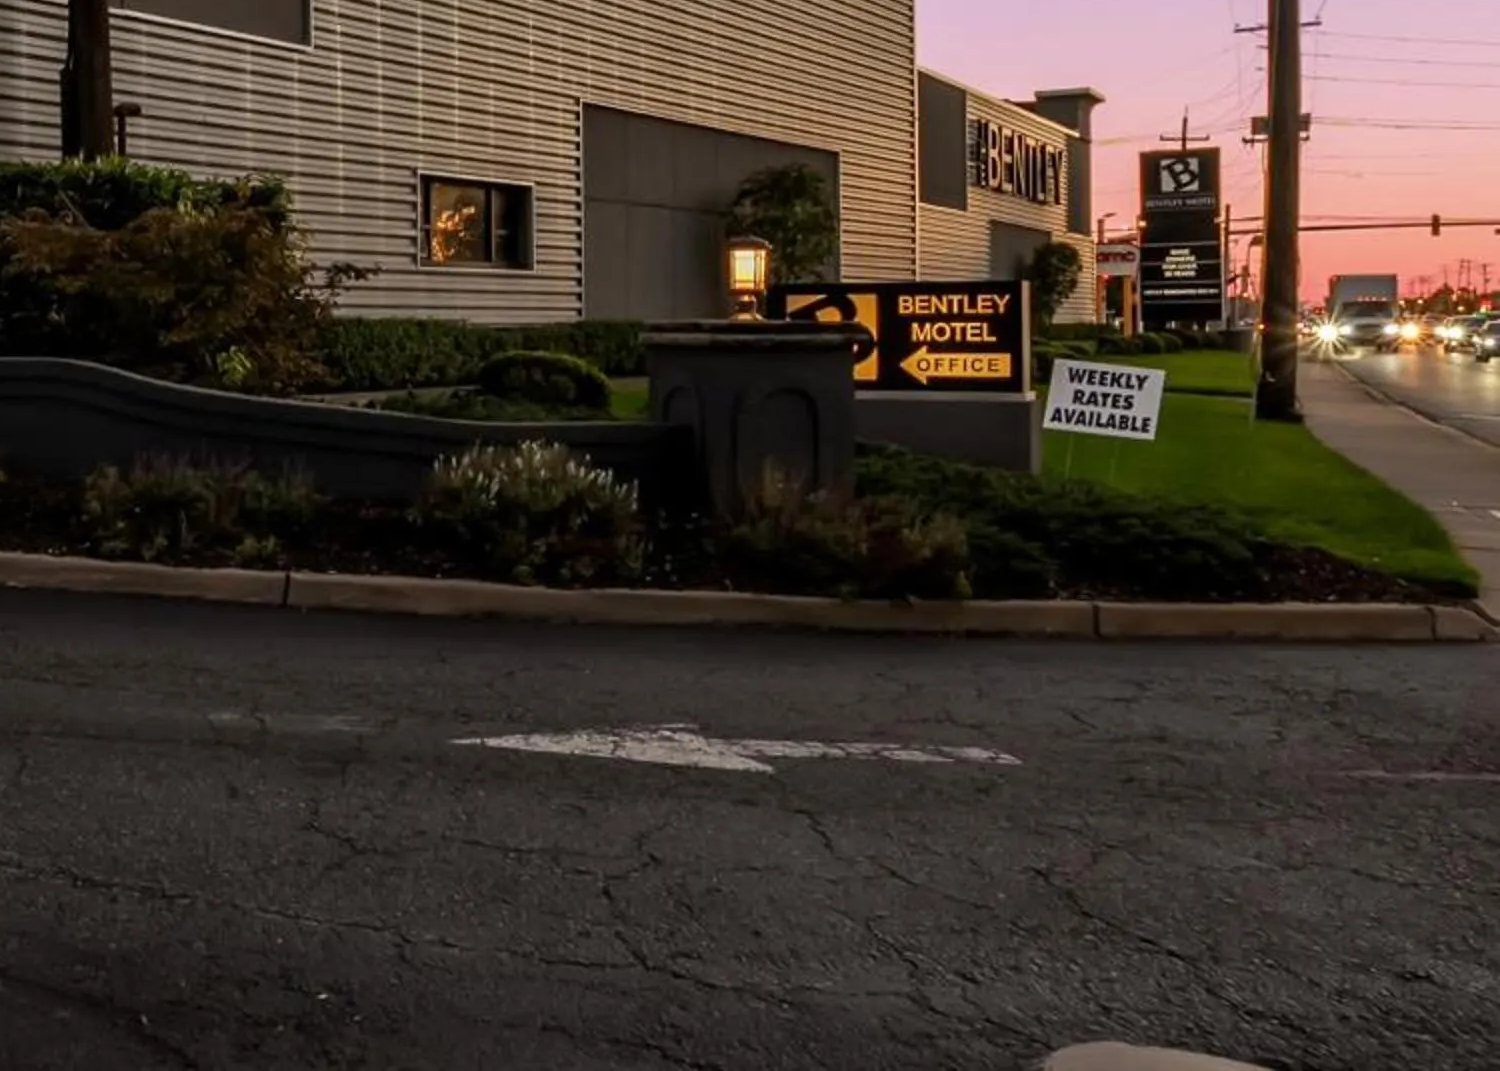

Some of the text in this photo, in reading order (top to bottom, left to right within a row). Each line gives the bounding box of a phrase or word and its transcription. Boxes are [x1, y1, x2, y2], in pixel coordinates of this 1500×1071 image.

[987, 121, 1063, 205] BENTLEY
[1161, 158, 1199, 192] B
[897, 294, 1011, 315] BENTLEY
[911, 322, 997, 343] MOTEL
[916, 357, 1001, 372] OFFICE
[1067, 367, 1150, 392] WEEKLY
[1072, 389, 1135, 410] RATES
[1050, 407, 1152, 434] AVAILABLE
